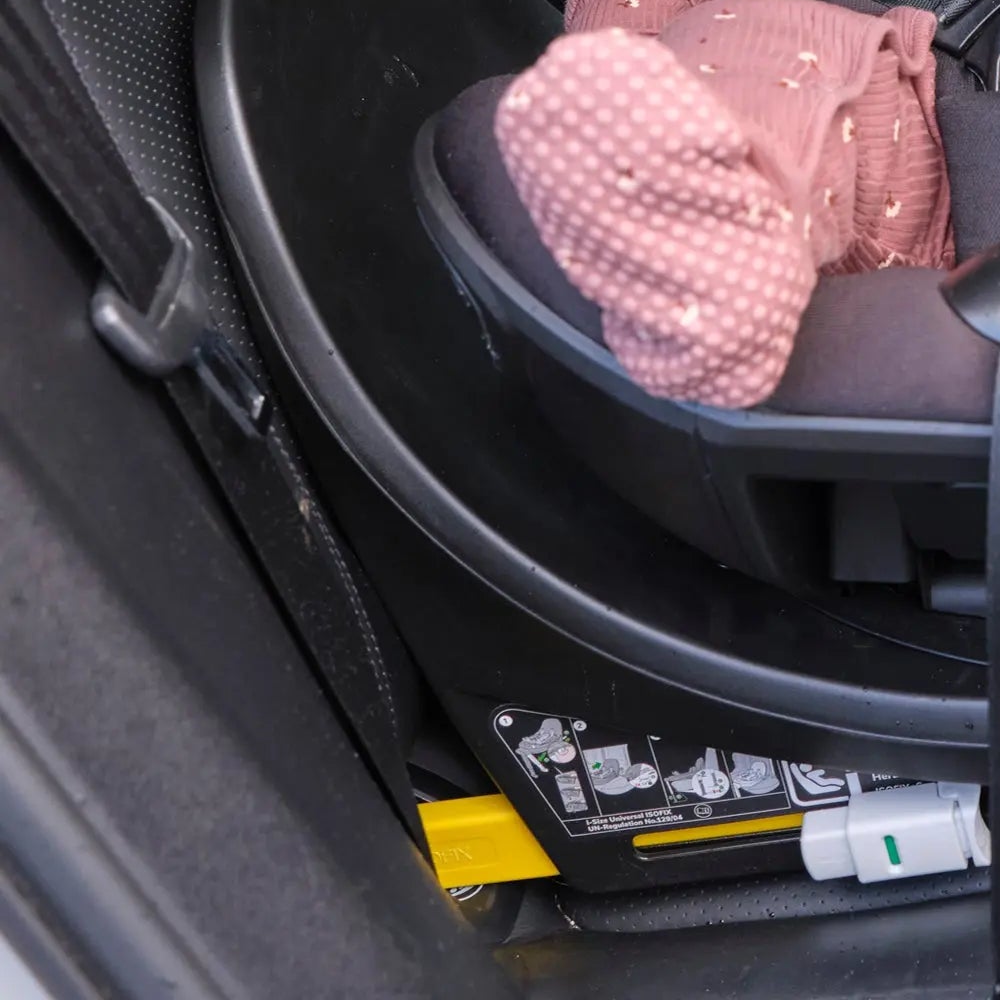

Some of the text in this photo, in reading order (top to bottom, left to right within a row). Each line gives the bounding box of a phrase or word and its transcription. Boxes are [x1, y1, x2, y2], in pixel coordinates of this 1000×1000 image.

[588, 814, 683, 832] UN-Regulation No.129/04
[609, 812, 645, 822] Universal
[645, 808, 673, 818] ISOFIX
